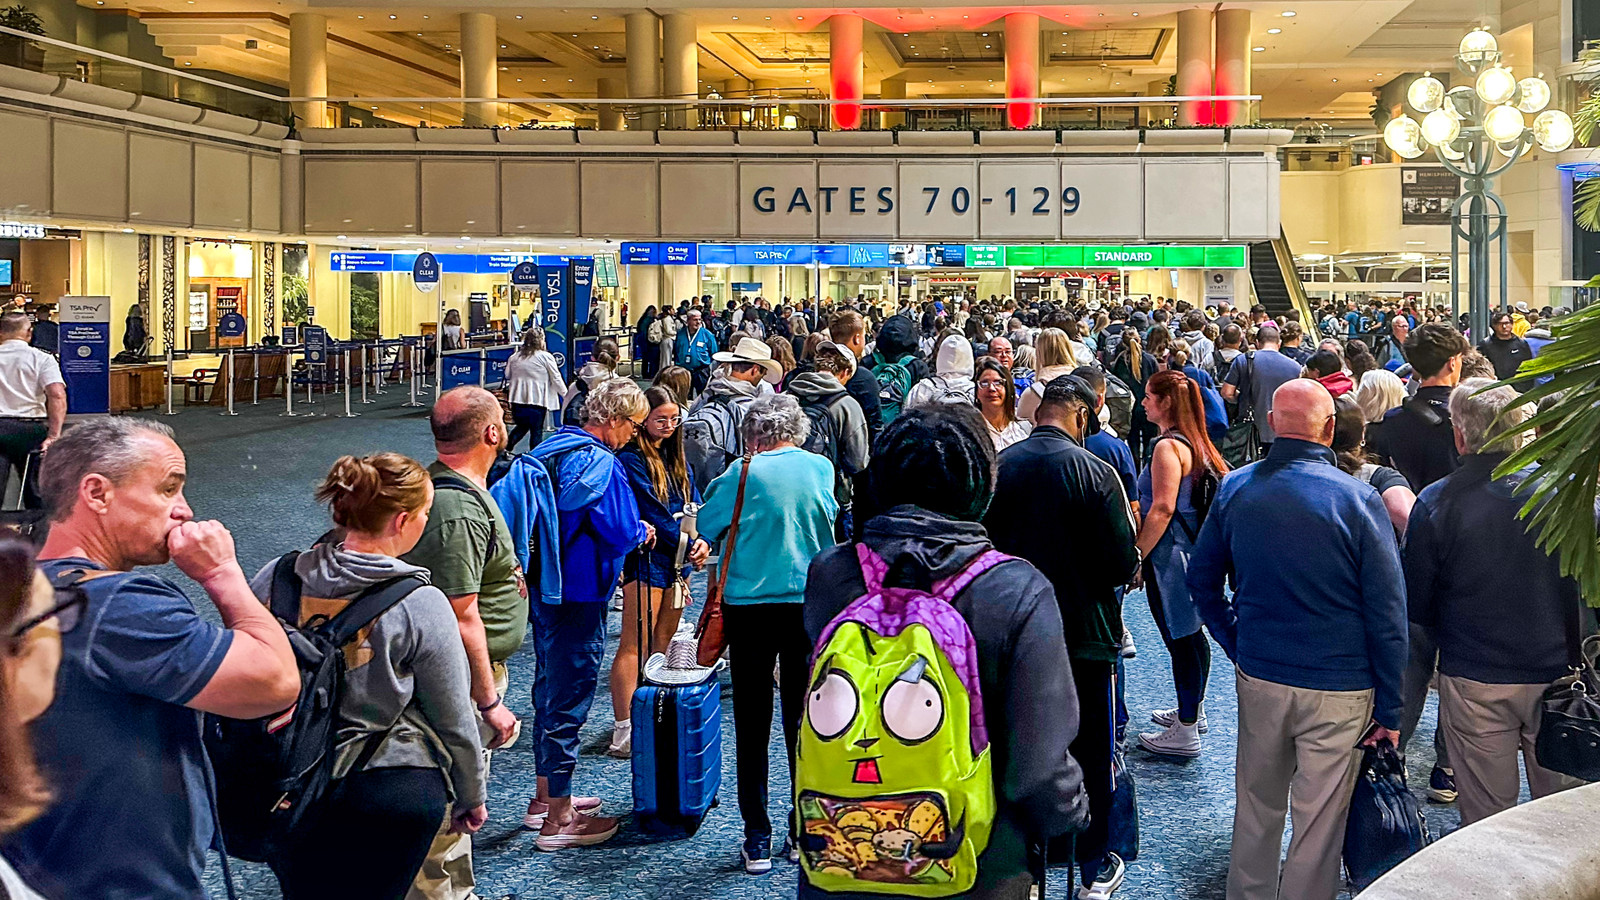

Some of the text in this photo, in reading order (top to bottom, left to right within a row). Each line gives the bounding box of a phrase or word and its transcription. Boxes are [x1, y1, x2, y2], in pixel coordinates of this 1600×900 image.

[753, 186, 1081, 214] GATES 70-129
[754, 251, 782, 259] TSA Pre
[1094, 251, 1153, 262] STANDARD
[547, 270, 560, 323] TSA Pre
